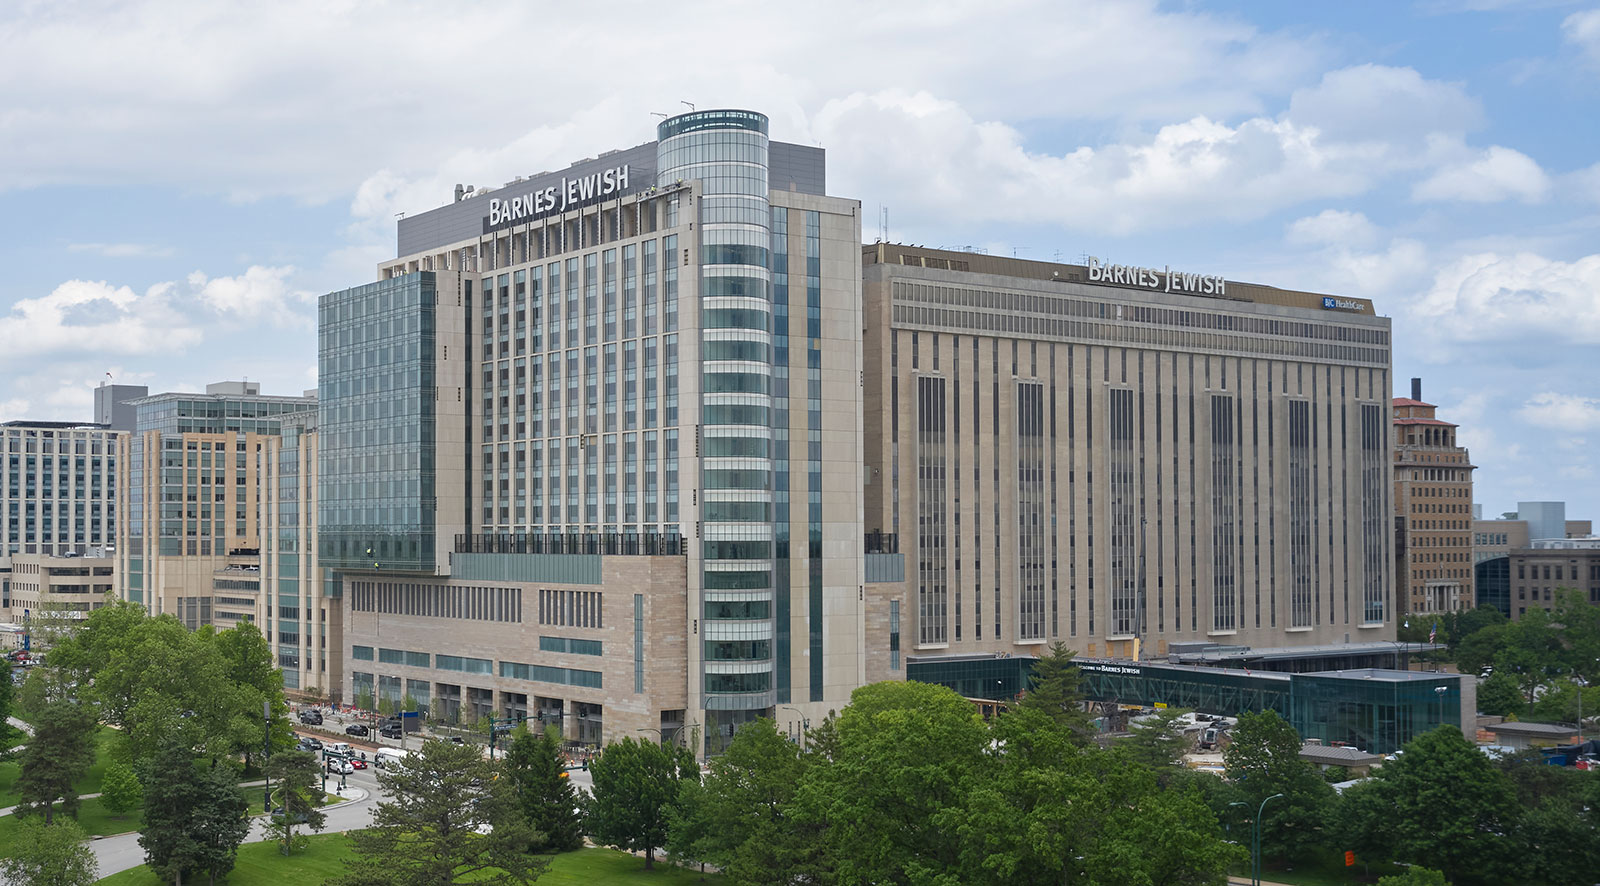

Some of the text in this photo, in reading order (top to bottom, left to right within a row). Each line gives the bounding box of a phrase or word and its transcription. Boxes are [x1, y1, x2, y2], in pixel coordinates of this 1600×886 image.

[490, 165, 629, 226] BARNES JEWISH
[1089, 256, 1225, 295] BARNES JEWISH
